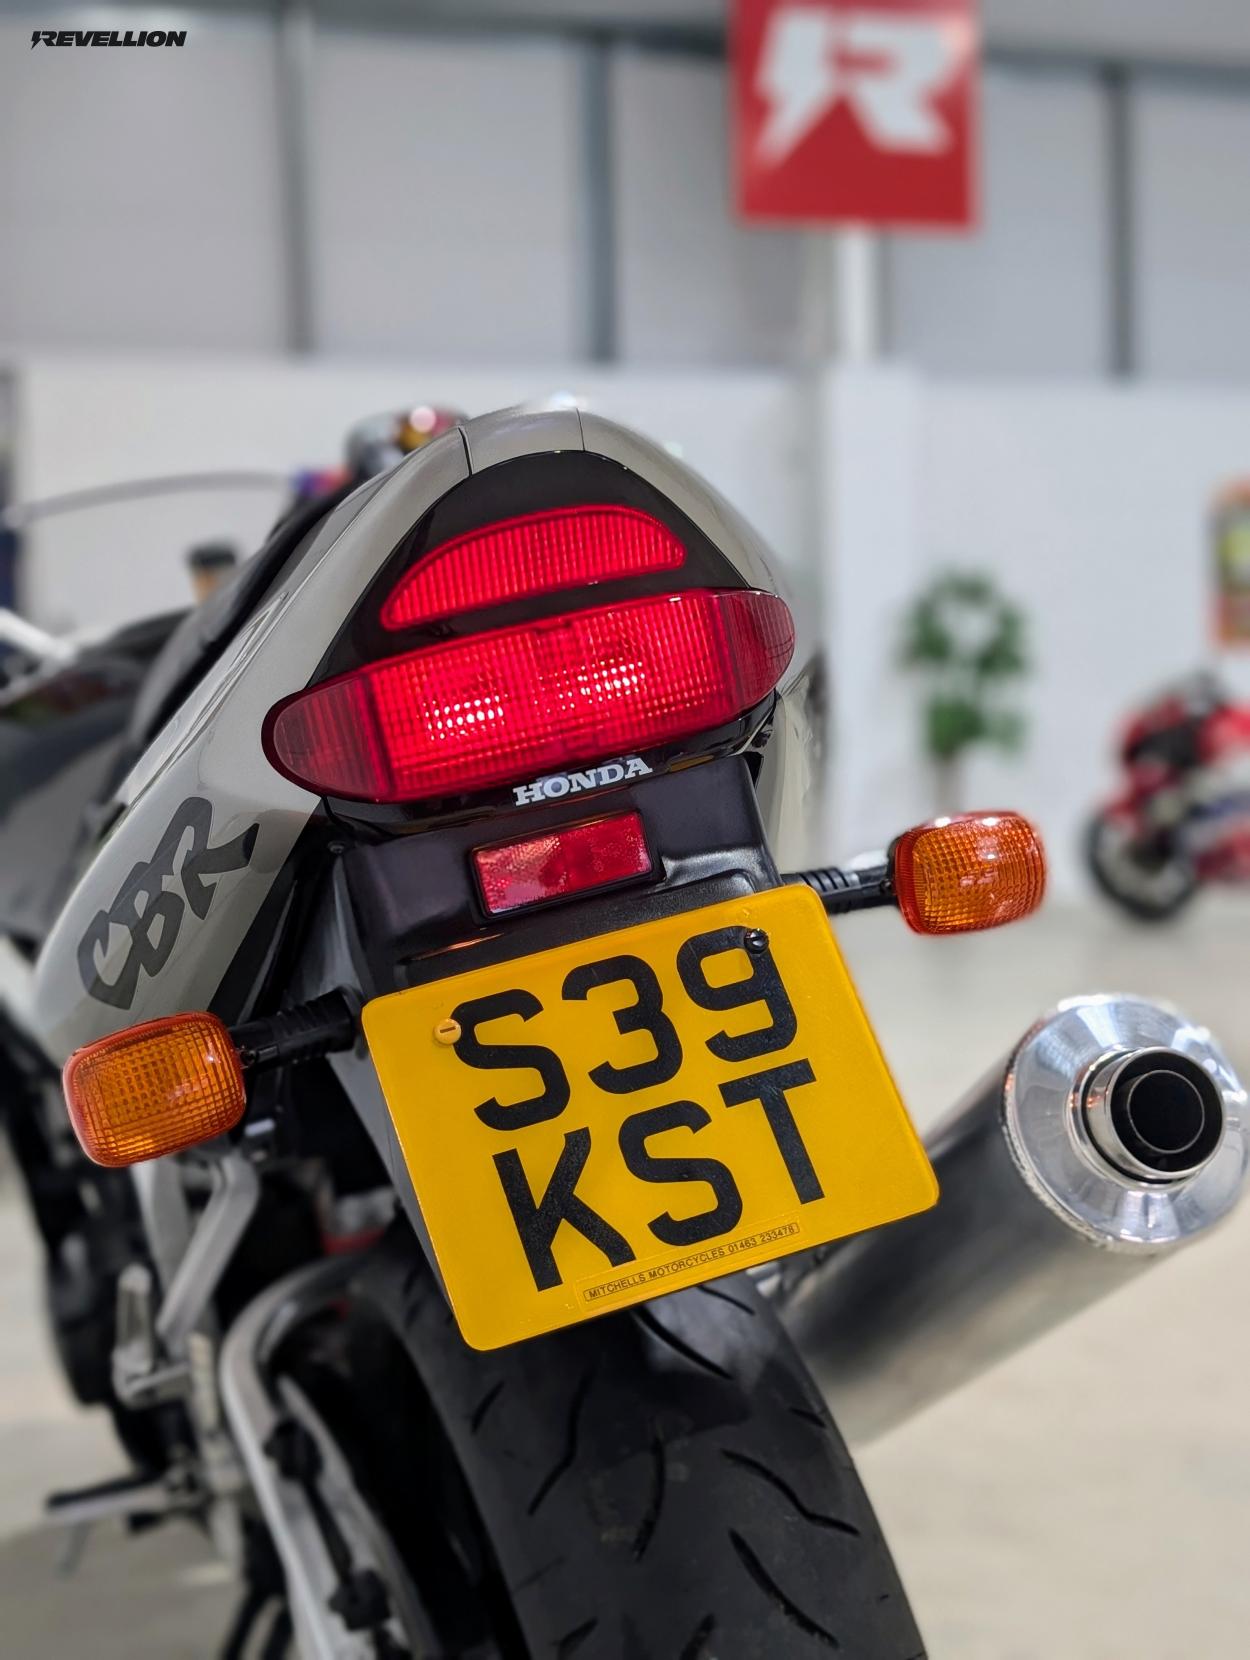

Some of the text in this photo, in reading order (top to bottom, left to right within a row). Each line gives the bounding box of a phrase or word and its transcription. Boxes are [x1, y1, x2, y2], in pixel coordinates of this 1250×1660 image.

[513, 757, 653, 806] HONDA
[77, 796, 260, 1010] CBR
[452, 925, 798, 1131] S39
[492, 1058, 825, 1292] KST
[588, 1224, 796, 1299] MITCHELLS MOTORCYCLES 01463 233478
